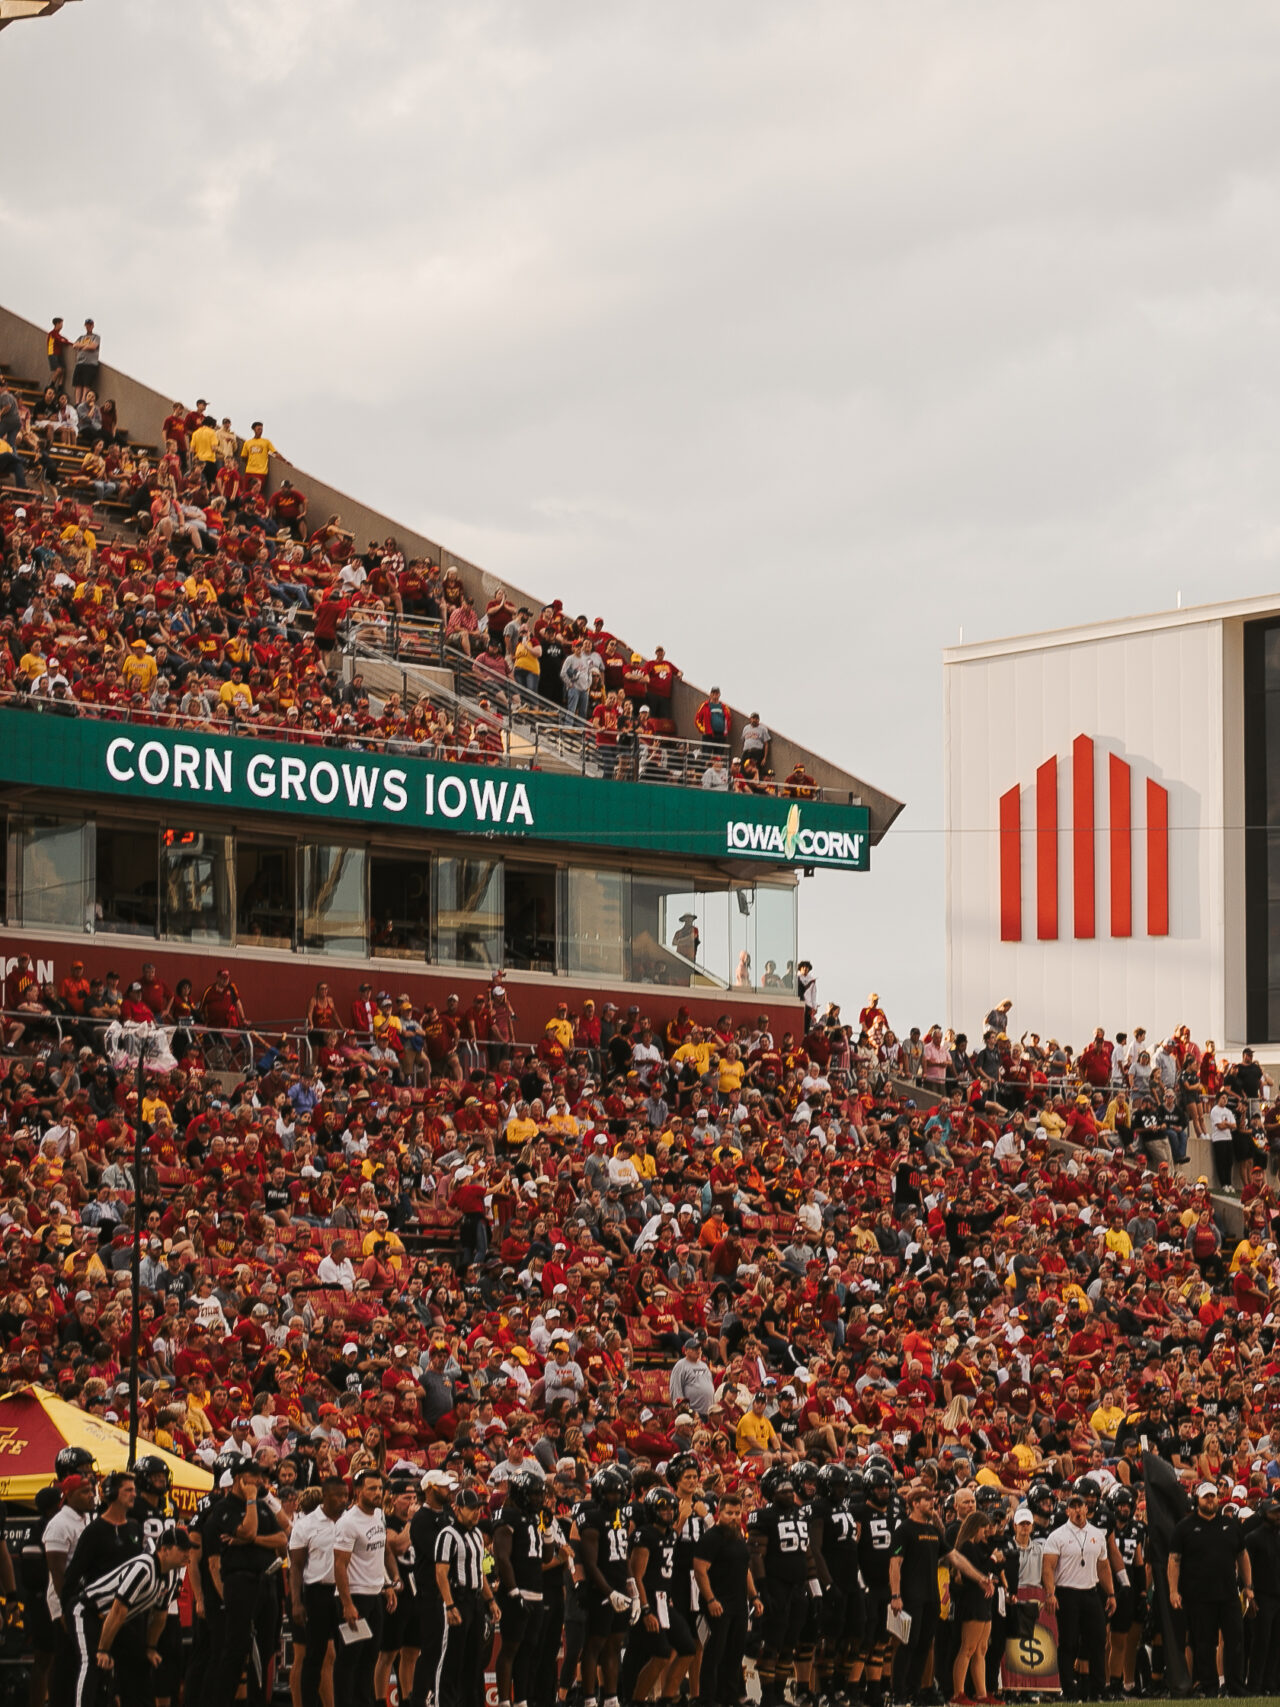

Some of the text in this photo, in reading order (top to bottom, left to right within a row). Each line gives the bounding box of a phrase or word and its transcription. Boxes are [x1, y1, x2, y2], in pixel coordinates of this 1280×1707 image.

[106, 737, 534, 825] CORN GROWS IOWA
[727, 821, 860, 859] IOWA CORN
[607, 1528, 628, 1561] 16
[778, 1520, 810, 1552] 55
[661, 1547, 674, 1579] 3
